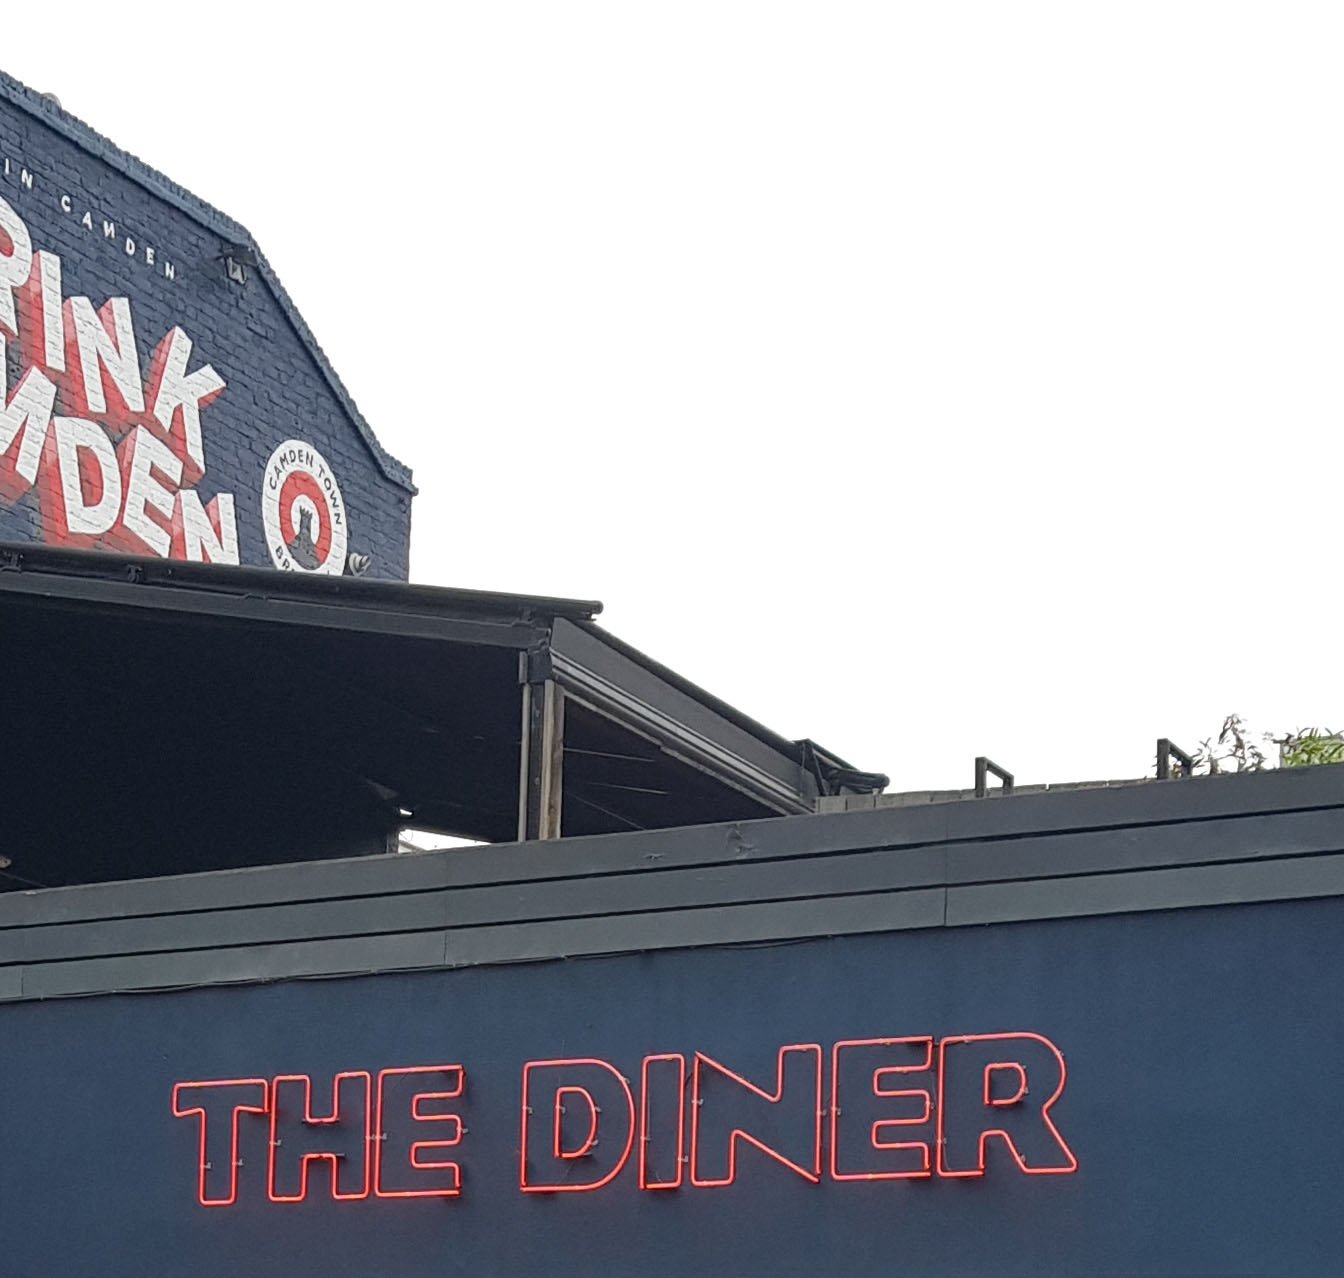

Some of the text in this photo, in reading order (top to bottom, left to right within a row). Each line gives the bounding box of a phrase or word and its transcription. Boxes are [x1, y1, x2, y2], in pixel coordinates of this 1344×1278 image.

[4, 158, 33, 189] IN
[60, 195, 175, 280] CAMDEN
[269, 449, 343, 525] CAMDEN TOWN
[172, 1031, 1078, 1204] THE DINER
